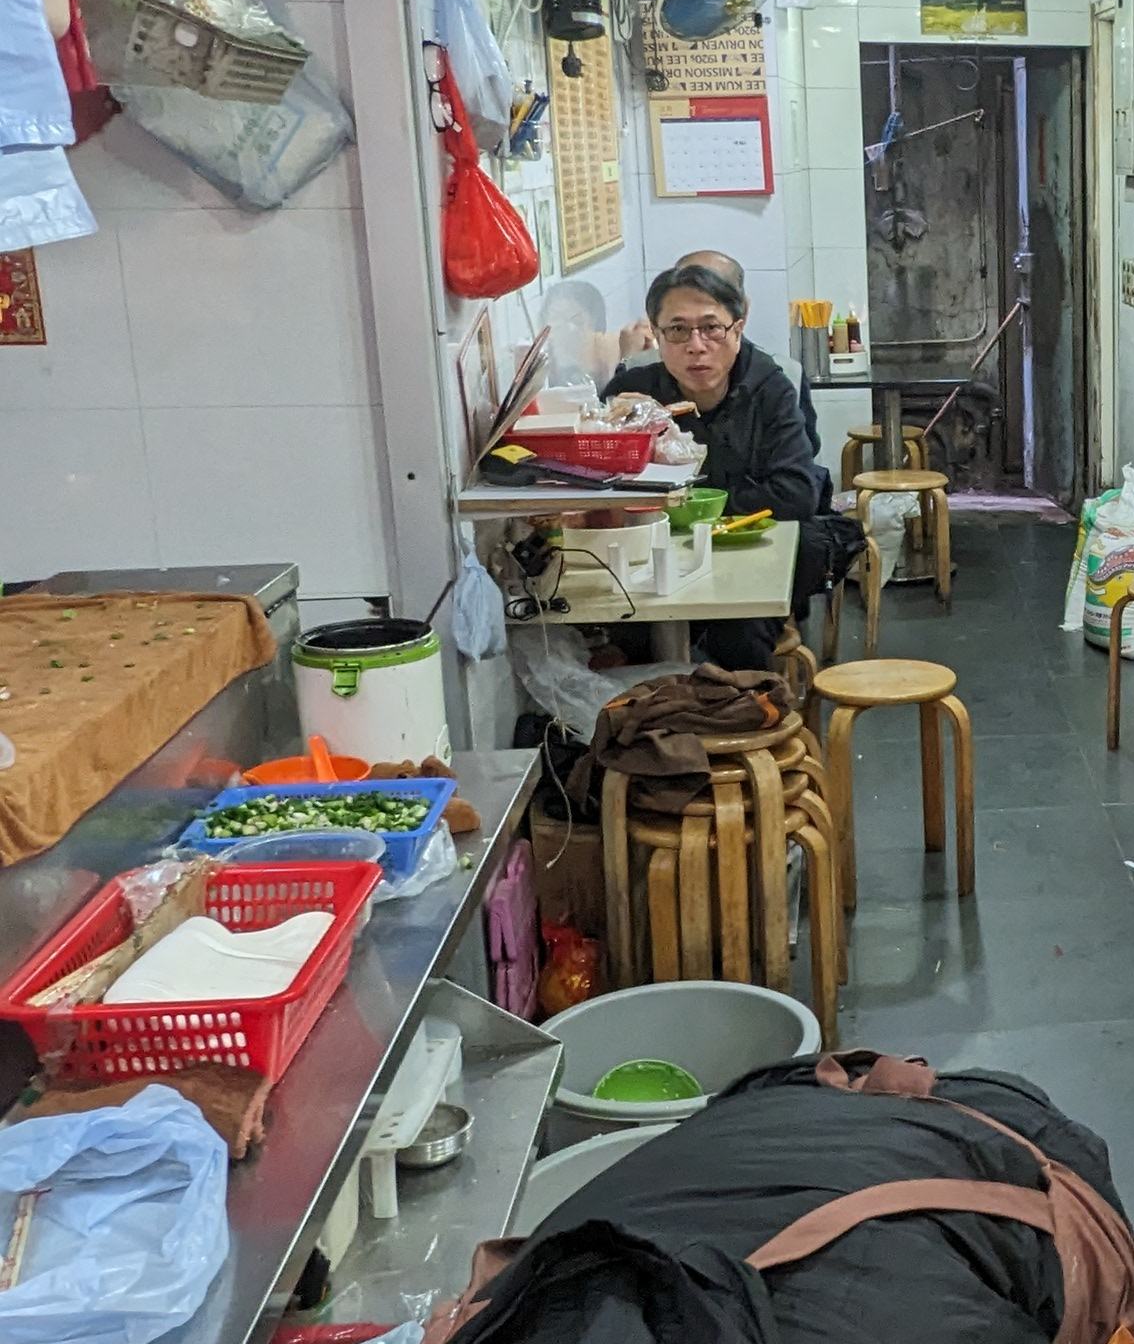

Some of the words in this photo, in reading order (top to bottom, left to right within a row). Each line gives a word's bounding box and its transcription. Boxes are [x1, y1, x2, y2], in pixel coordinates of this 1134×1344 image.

[701, 40, 746, 50] DRIVEN
[667, 55, 688, 65] LEE
[685, 67, 733, 78] MISSION
[690, 82, 712, 92] KEE
[715, 81, 743, 91] KUM
[745, 80, 767, 90] LEE
